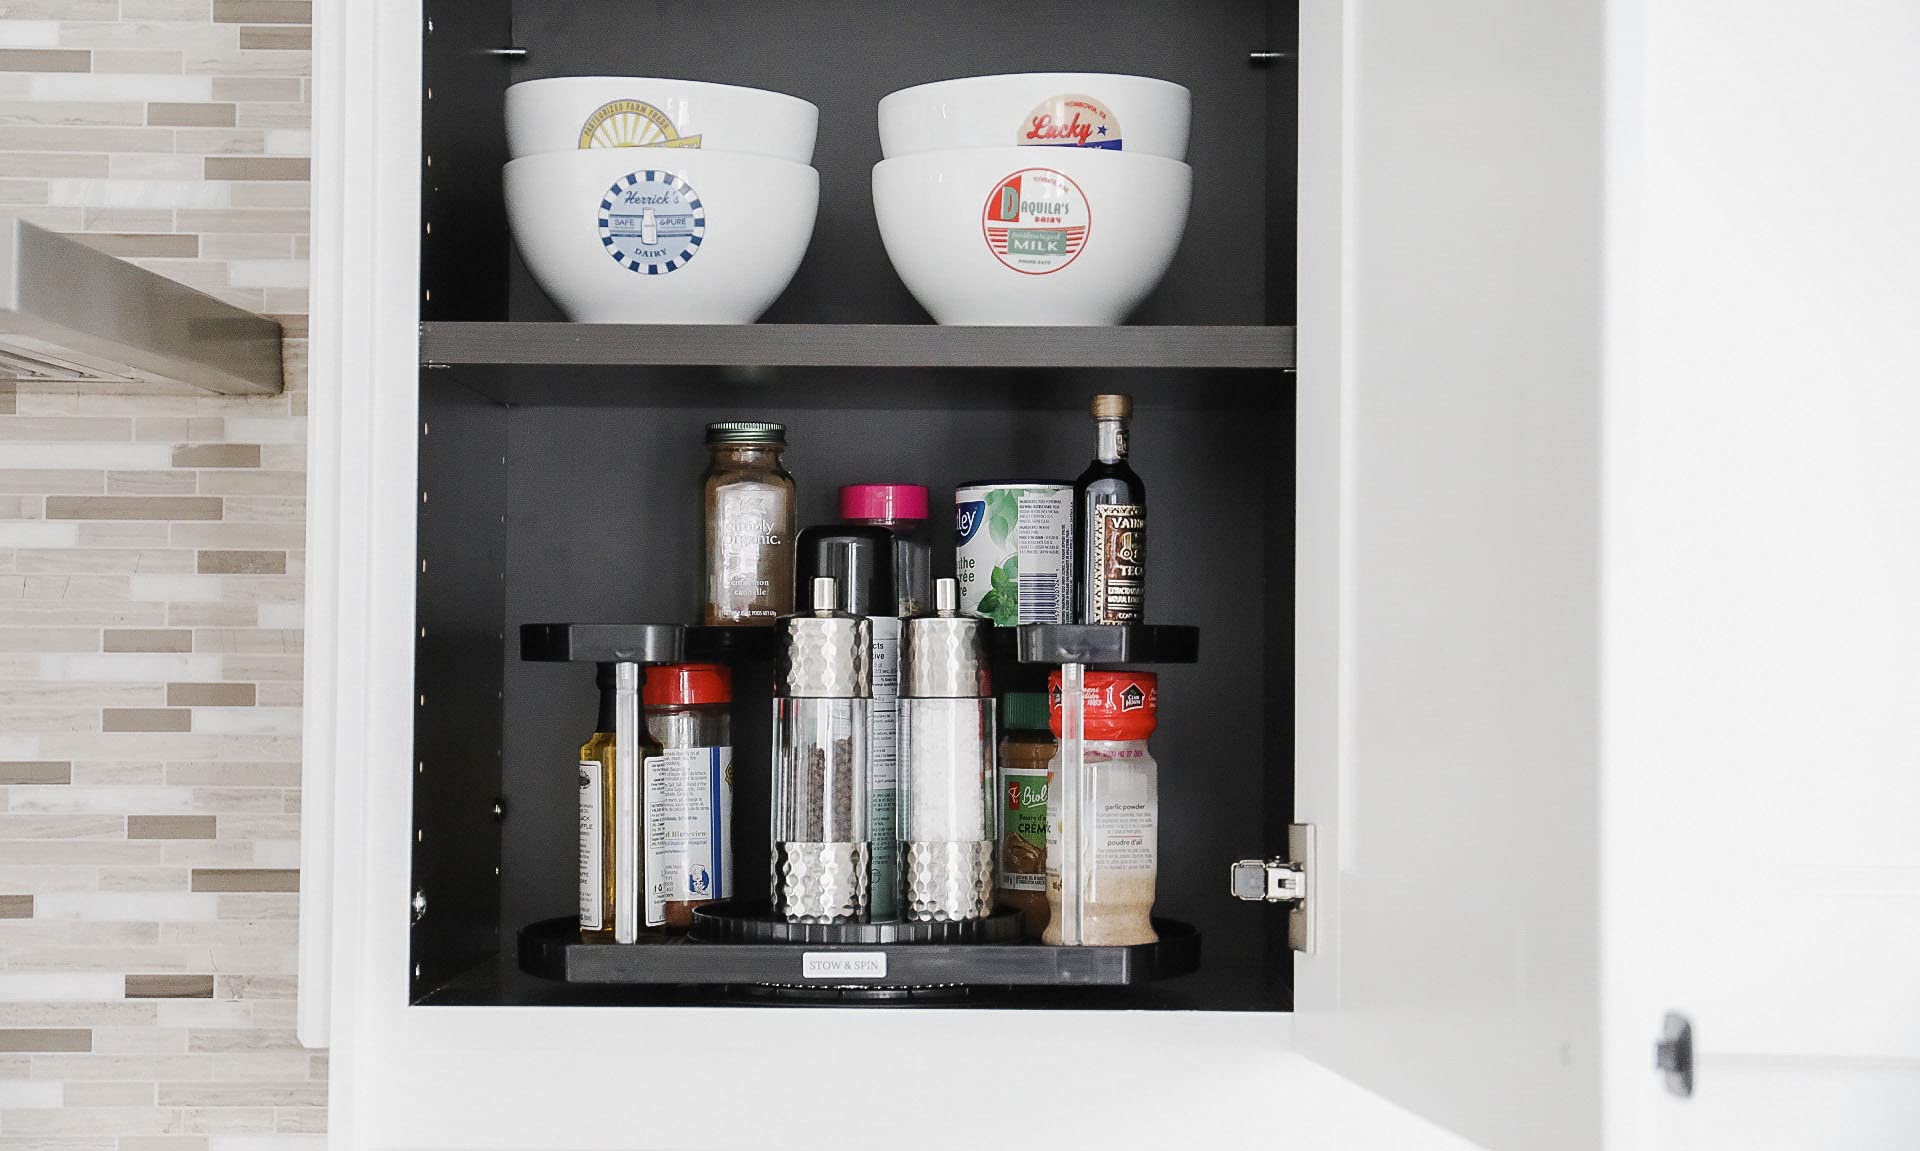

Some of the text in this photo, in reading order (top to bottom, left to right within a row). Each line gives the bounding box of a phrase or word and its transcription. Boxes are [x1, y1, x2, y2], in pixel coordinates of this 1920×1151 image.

[626, 102, 646, 112] FARM
[648, 110, 669, 129] FRESH
[1026, 112, 1093, 146] Lucky
[624, 190, 679, 204] Herrick's
[634, 247, 667, 257] DAIRY
[1014, 240, 1058, 252] MILK
[1105, 803, 1146, 812] garlic powder
[1018, 821, 1047, 834] CRÉM
[1107, 838, 1143, 847] poudre d'ail
[809, 960, 878, 970] STOW & SPIN
